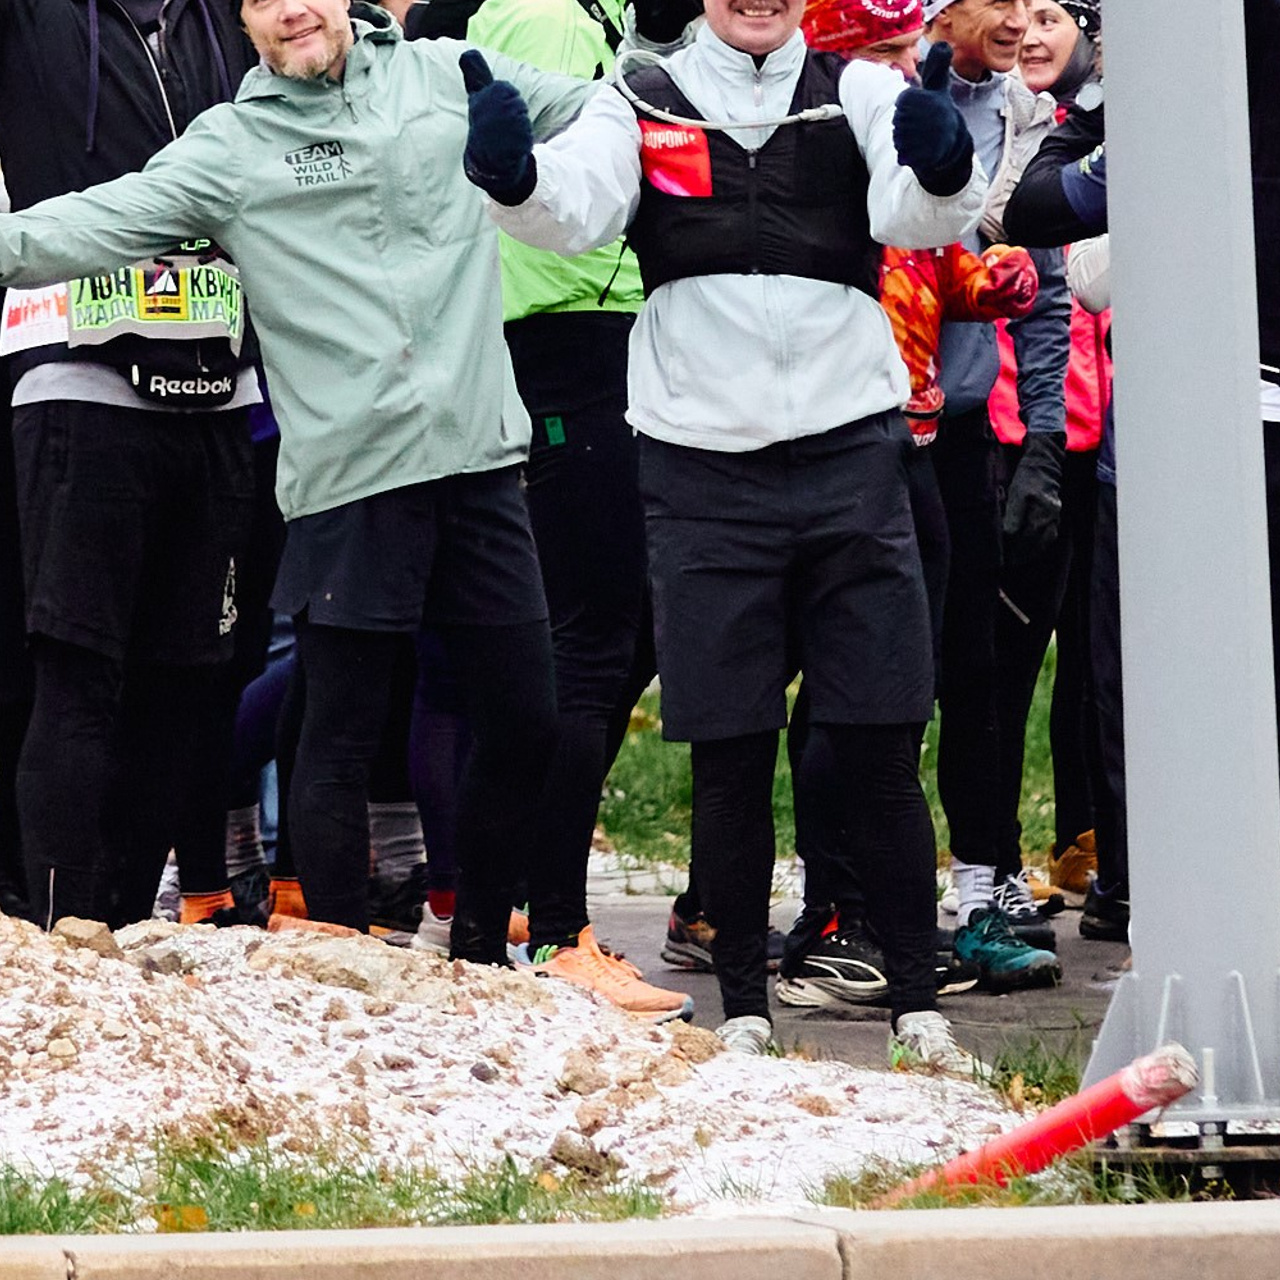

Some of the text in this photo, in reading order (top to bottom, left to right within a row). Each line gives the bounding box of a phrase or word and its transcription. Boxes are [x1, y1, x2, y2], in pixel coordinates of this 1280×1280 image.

[285, 141, 343, 165] TEAM
[293, 162, 333, 175] WILD
[294, 173, 340, 187] TRAIL
[150, 375, 231, 397] Reebok
